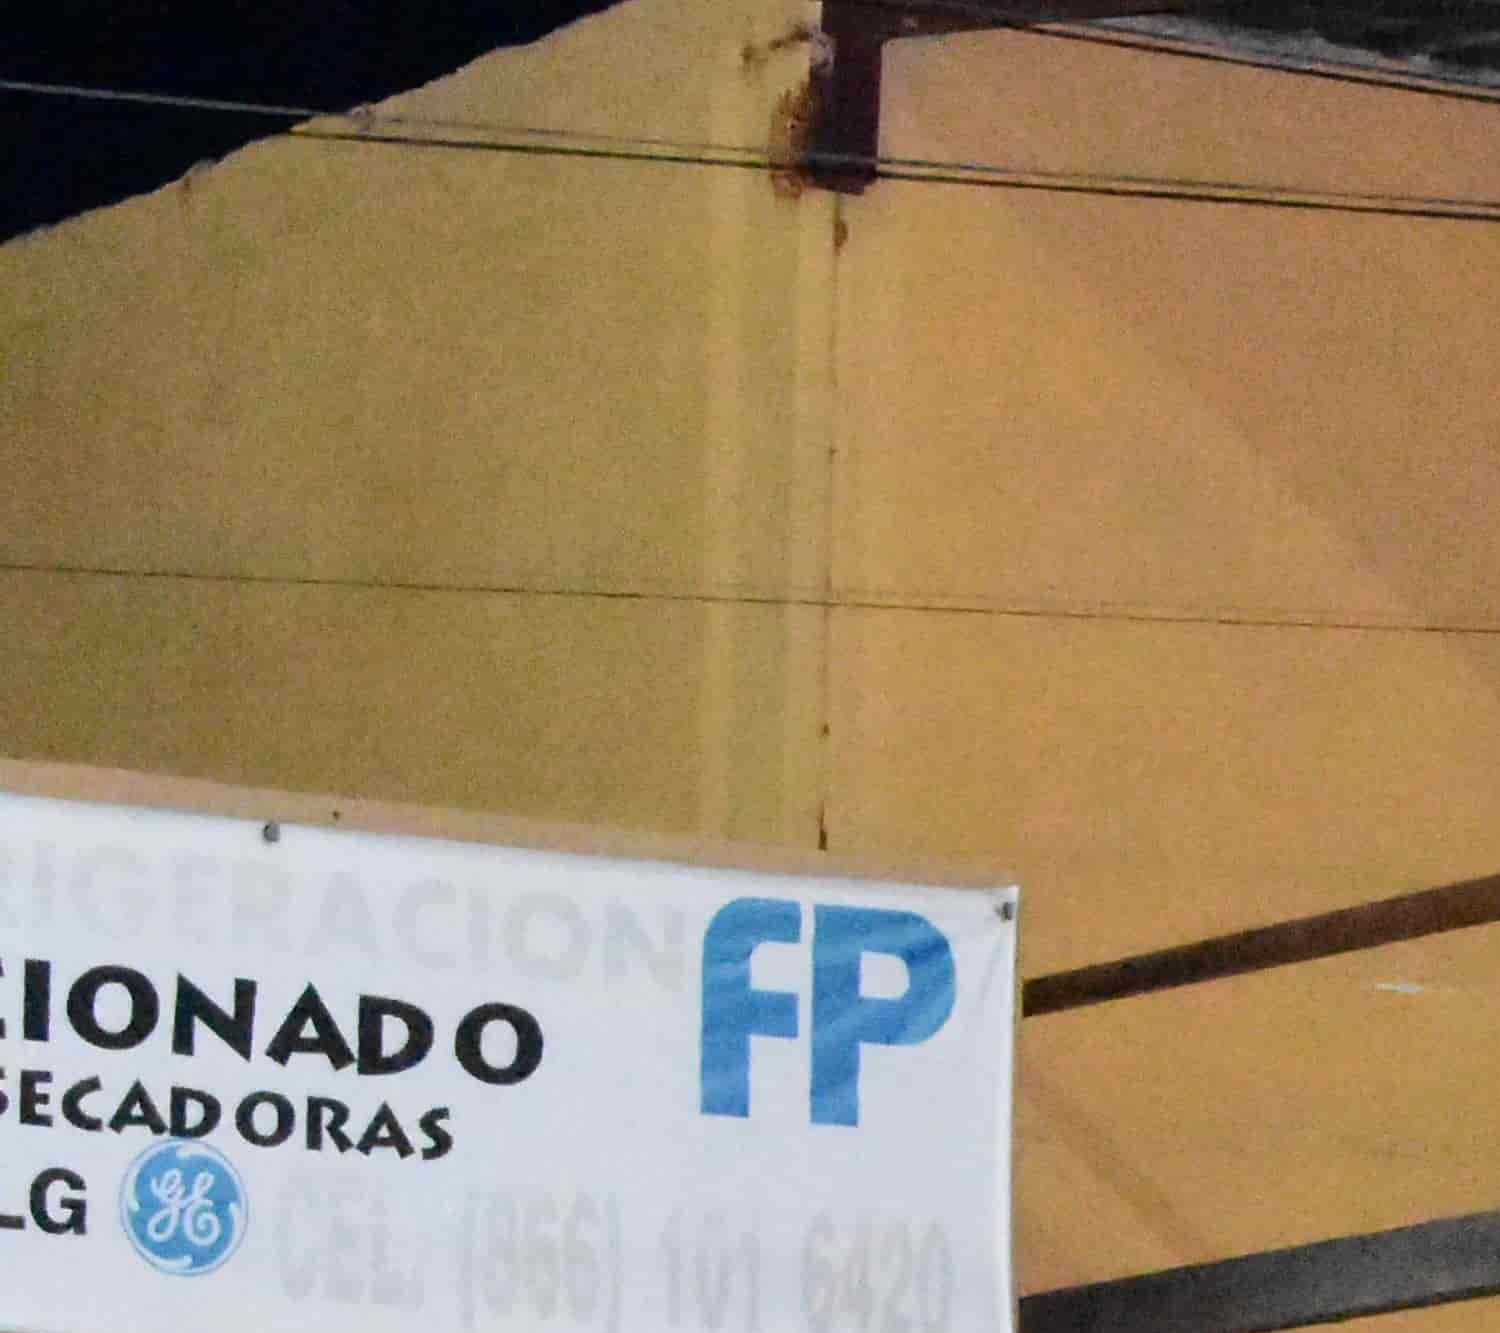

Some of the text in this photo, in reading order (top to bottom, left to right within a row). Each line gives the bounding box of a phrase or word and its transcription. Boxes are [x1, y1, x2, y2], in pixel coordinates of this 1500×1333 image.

[0, 840, 688, 992] IGERACION
[0, 958, 545, 1086] IONADO
[700, 896, 957, 1128] FP
